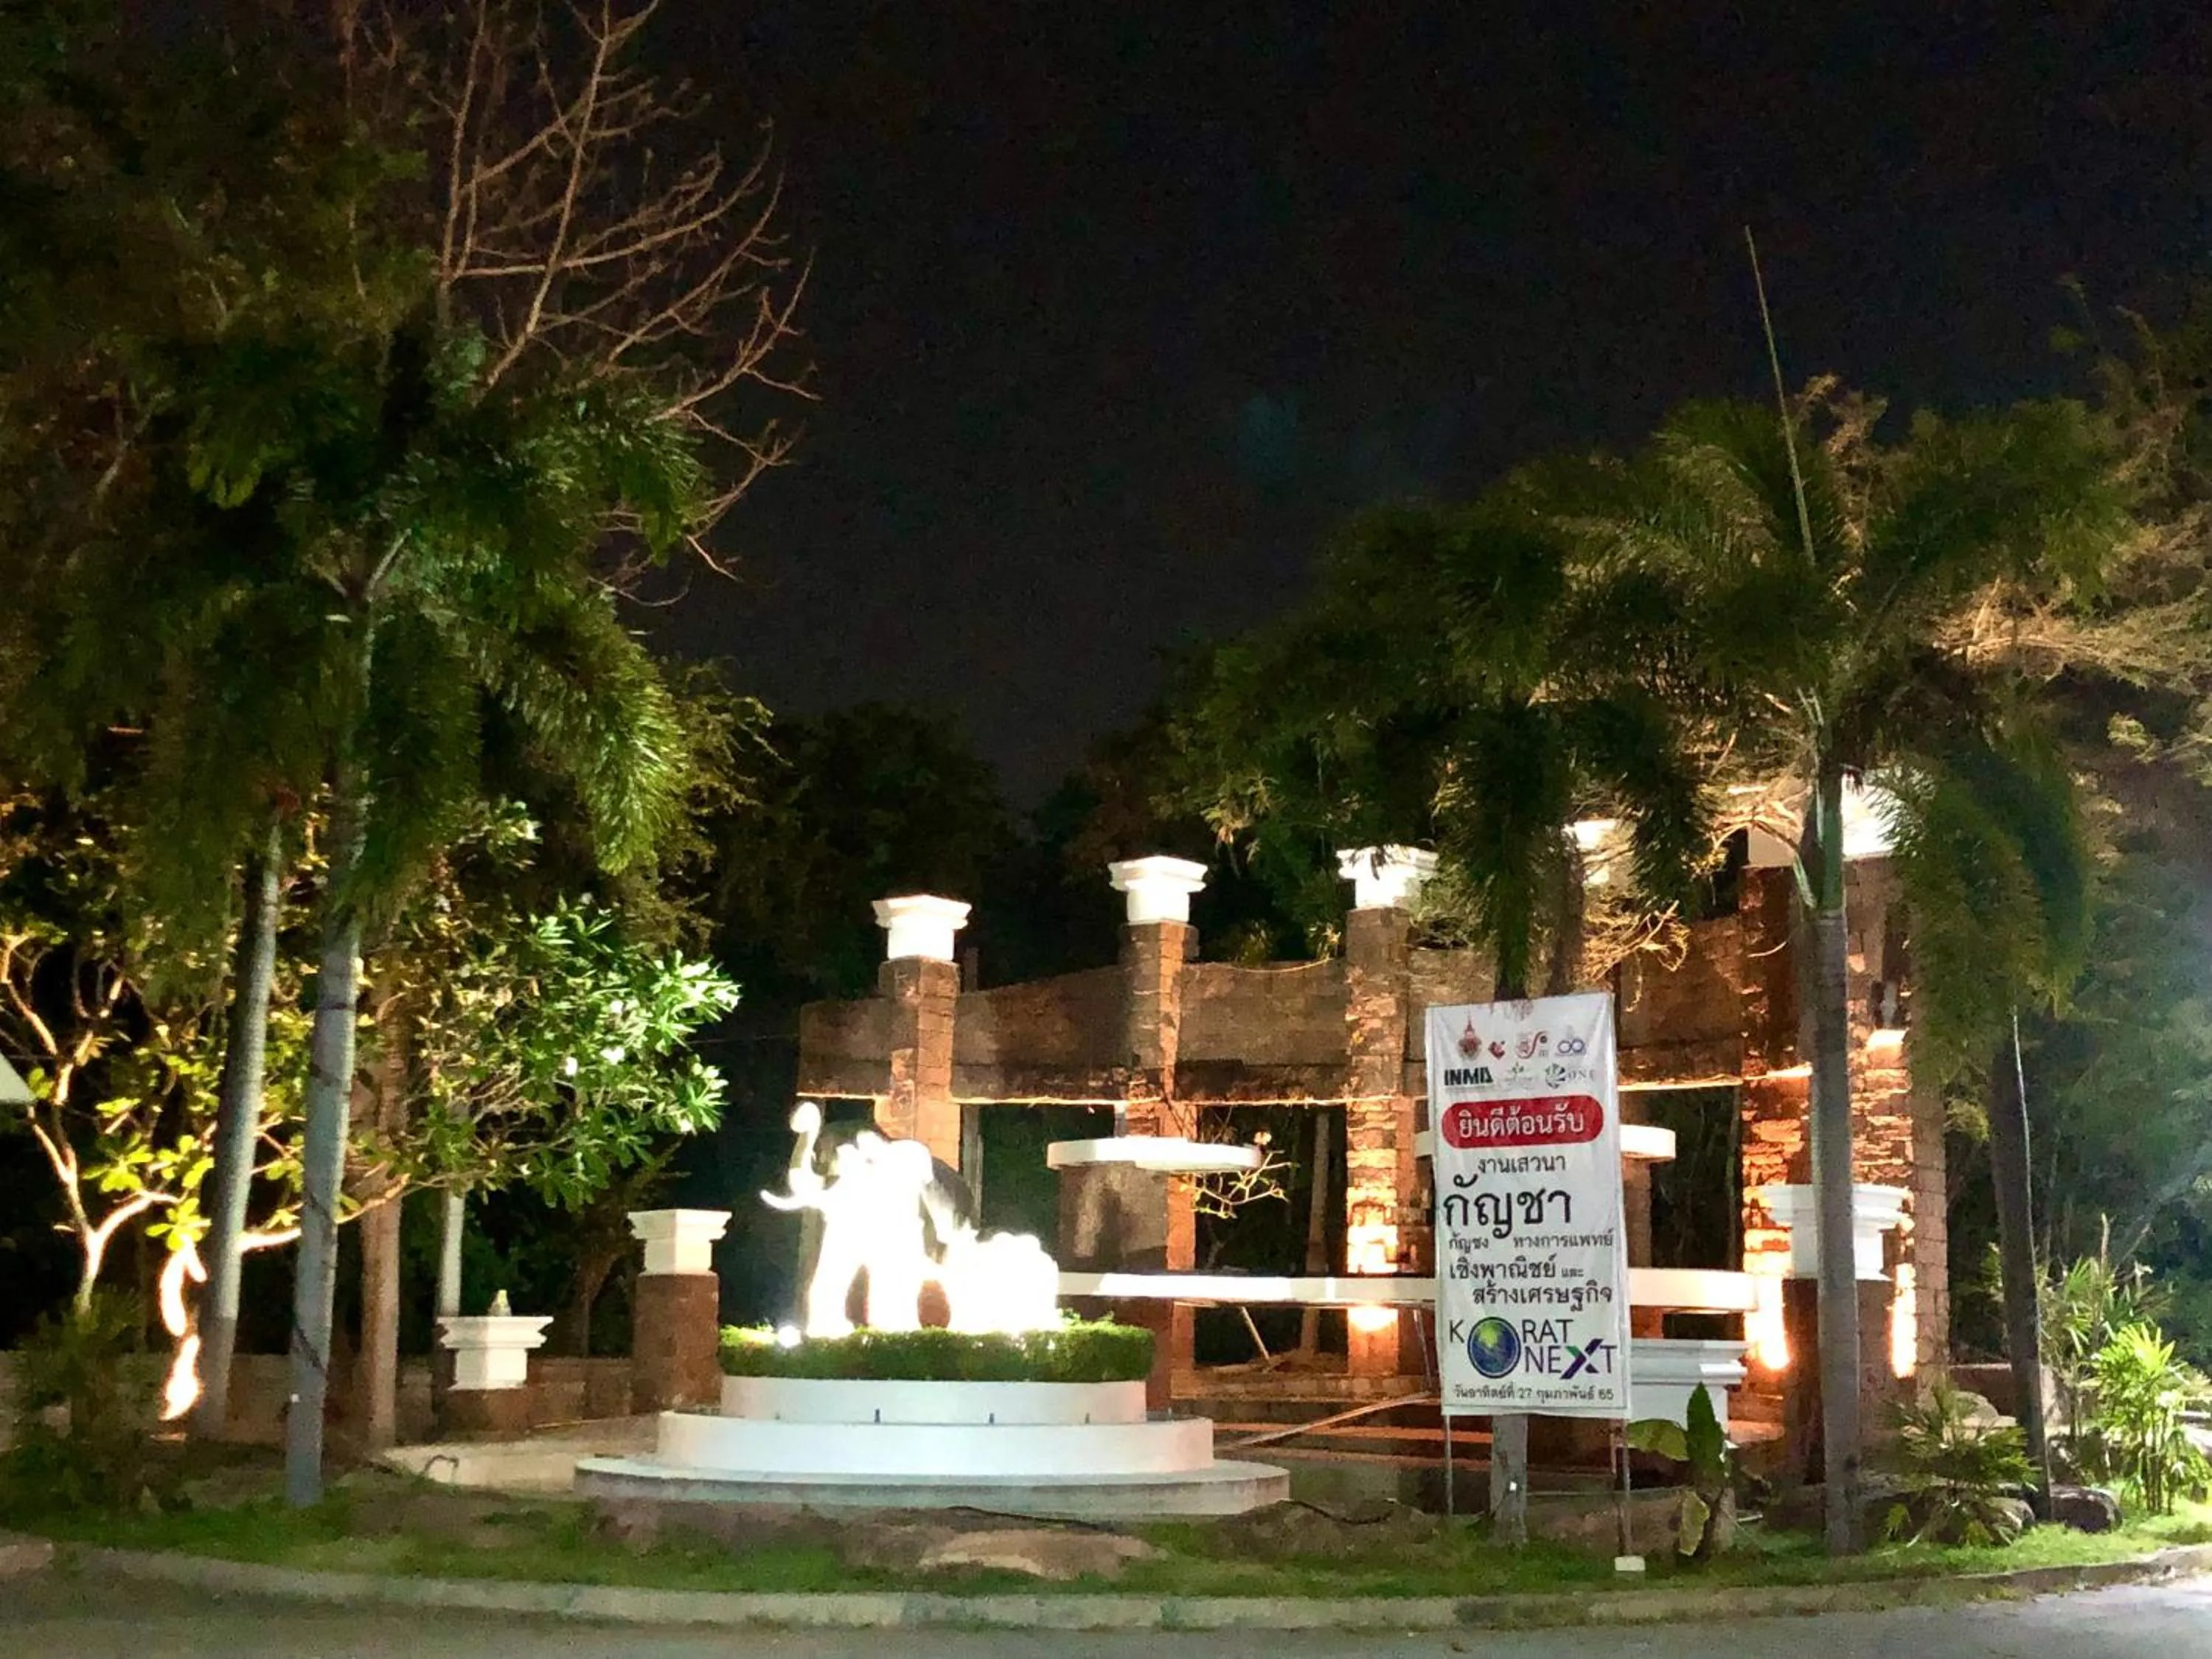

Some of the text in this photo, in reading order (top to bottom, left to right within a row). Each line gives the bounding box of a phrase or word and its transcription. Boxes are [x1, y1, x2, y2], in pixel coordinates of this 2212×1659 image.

[1458, 1102, 1584, 1138] ยินดีต้อนรับ
[1477, 1155, 1566, 1174] งานเสวนา
[1442, 1173, 1571, 1239] กัญชา
[1513, 1228, 1614, 1248] ทางการแพทย์
[1450, 1253, 1557, 1279] เชิงพาณิชย์
[1472, 1279, 1613, 1312] สร้างเศรษฐกิจ
[1524, 1338, 1618, 1380] NEXT
